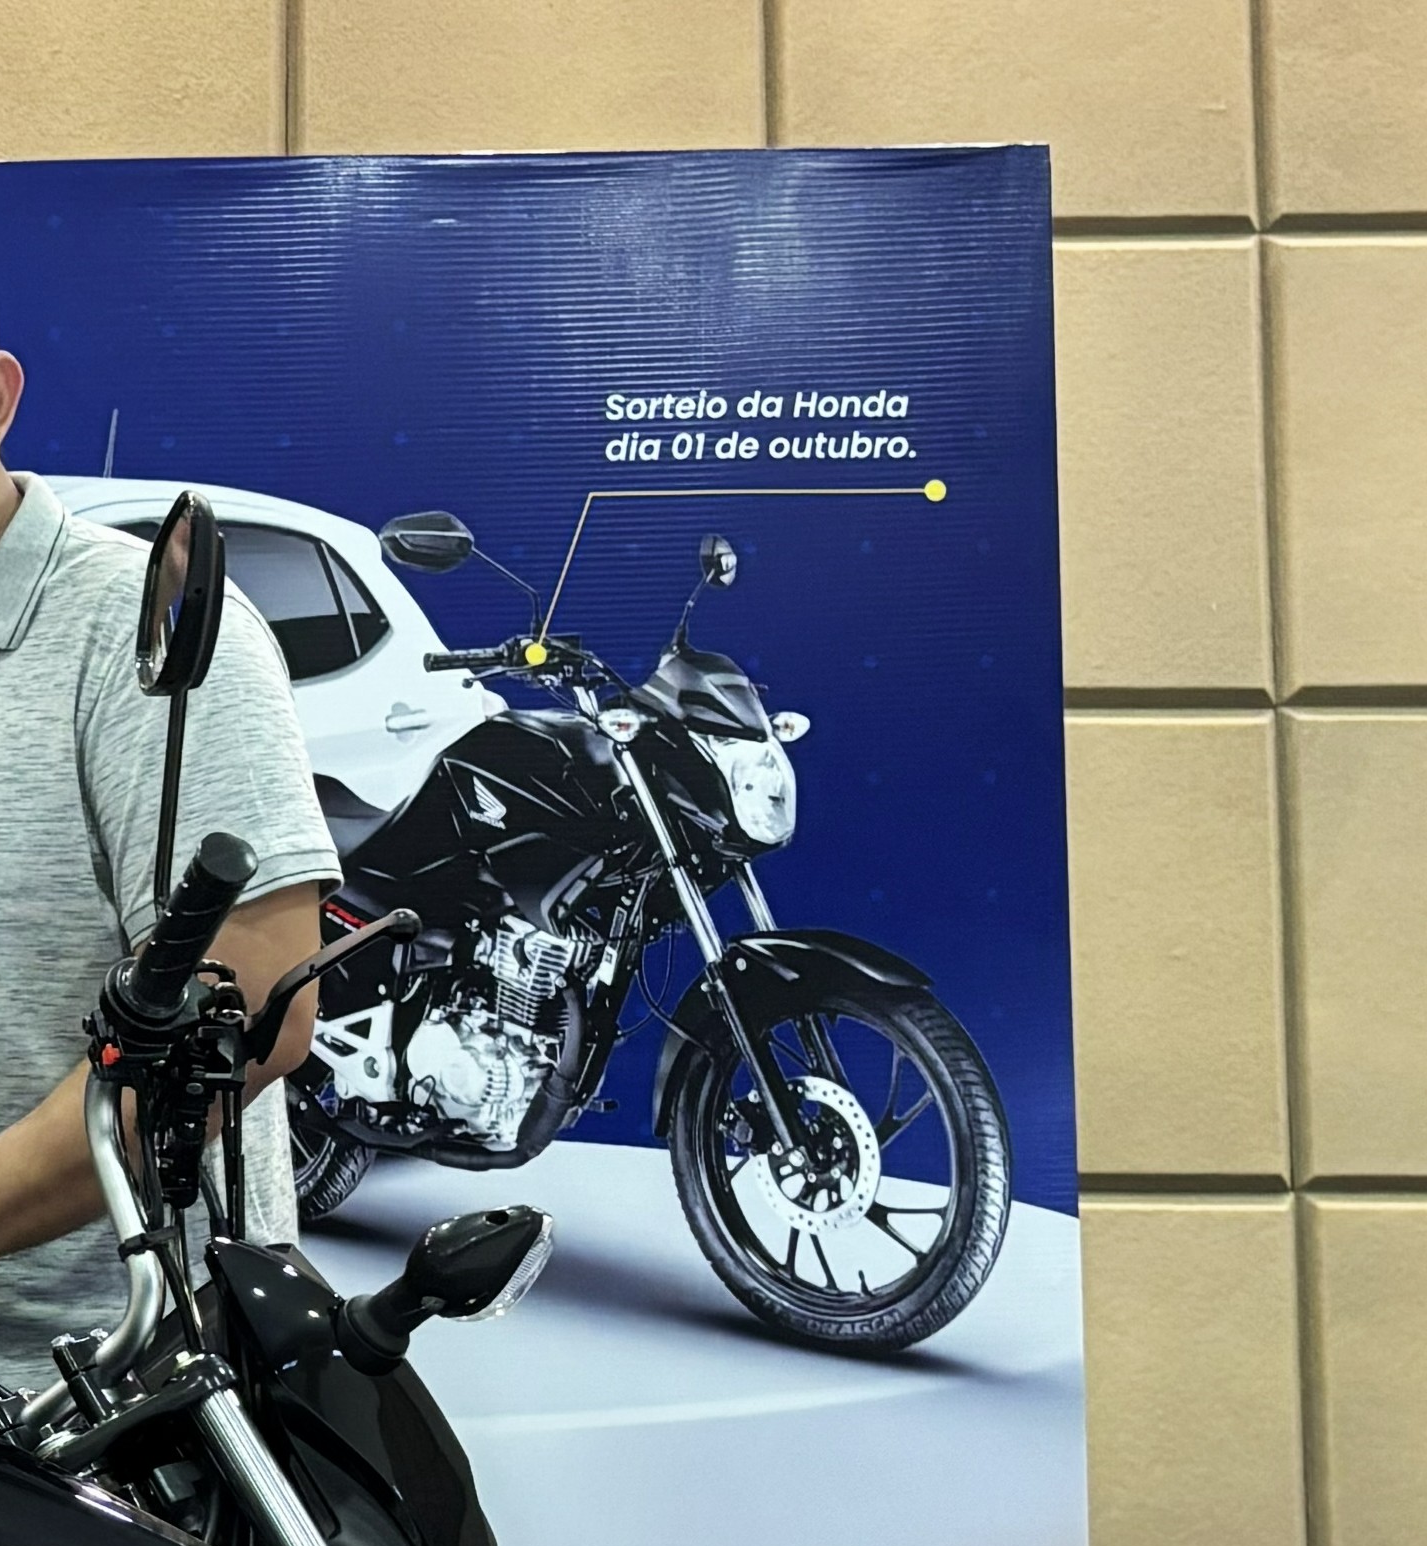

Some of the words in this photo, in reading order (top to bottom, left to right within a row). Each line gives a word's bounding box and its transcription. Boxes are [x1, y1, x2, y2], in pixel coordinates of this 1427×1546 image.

[605, 390, 728, 421] Sorteio
[736, 390, 784, 419] da
[793, 389, 910, 419] Honda
[605, 431, 662, 462] dia
[671, 432, 706, 460] 01
[714, 430, 760, 460] de
[768, 430, 918, 460] outubro.
